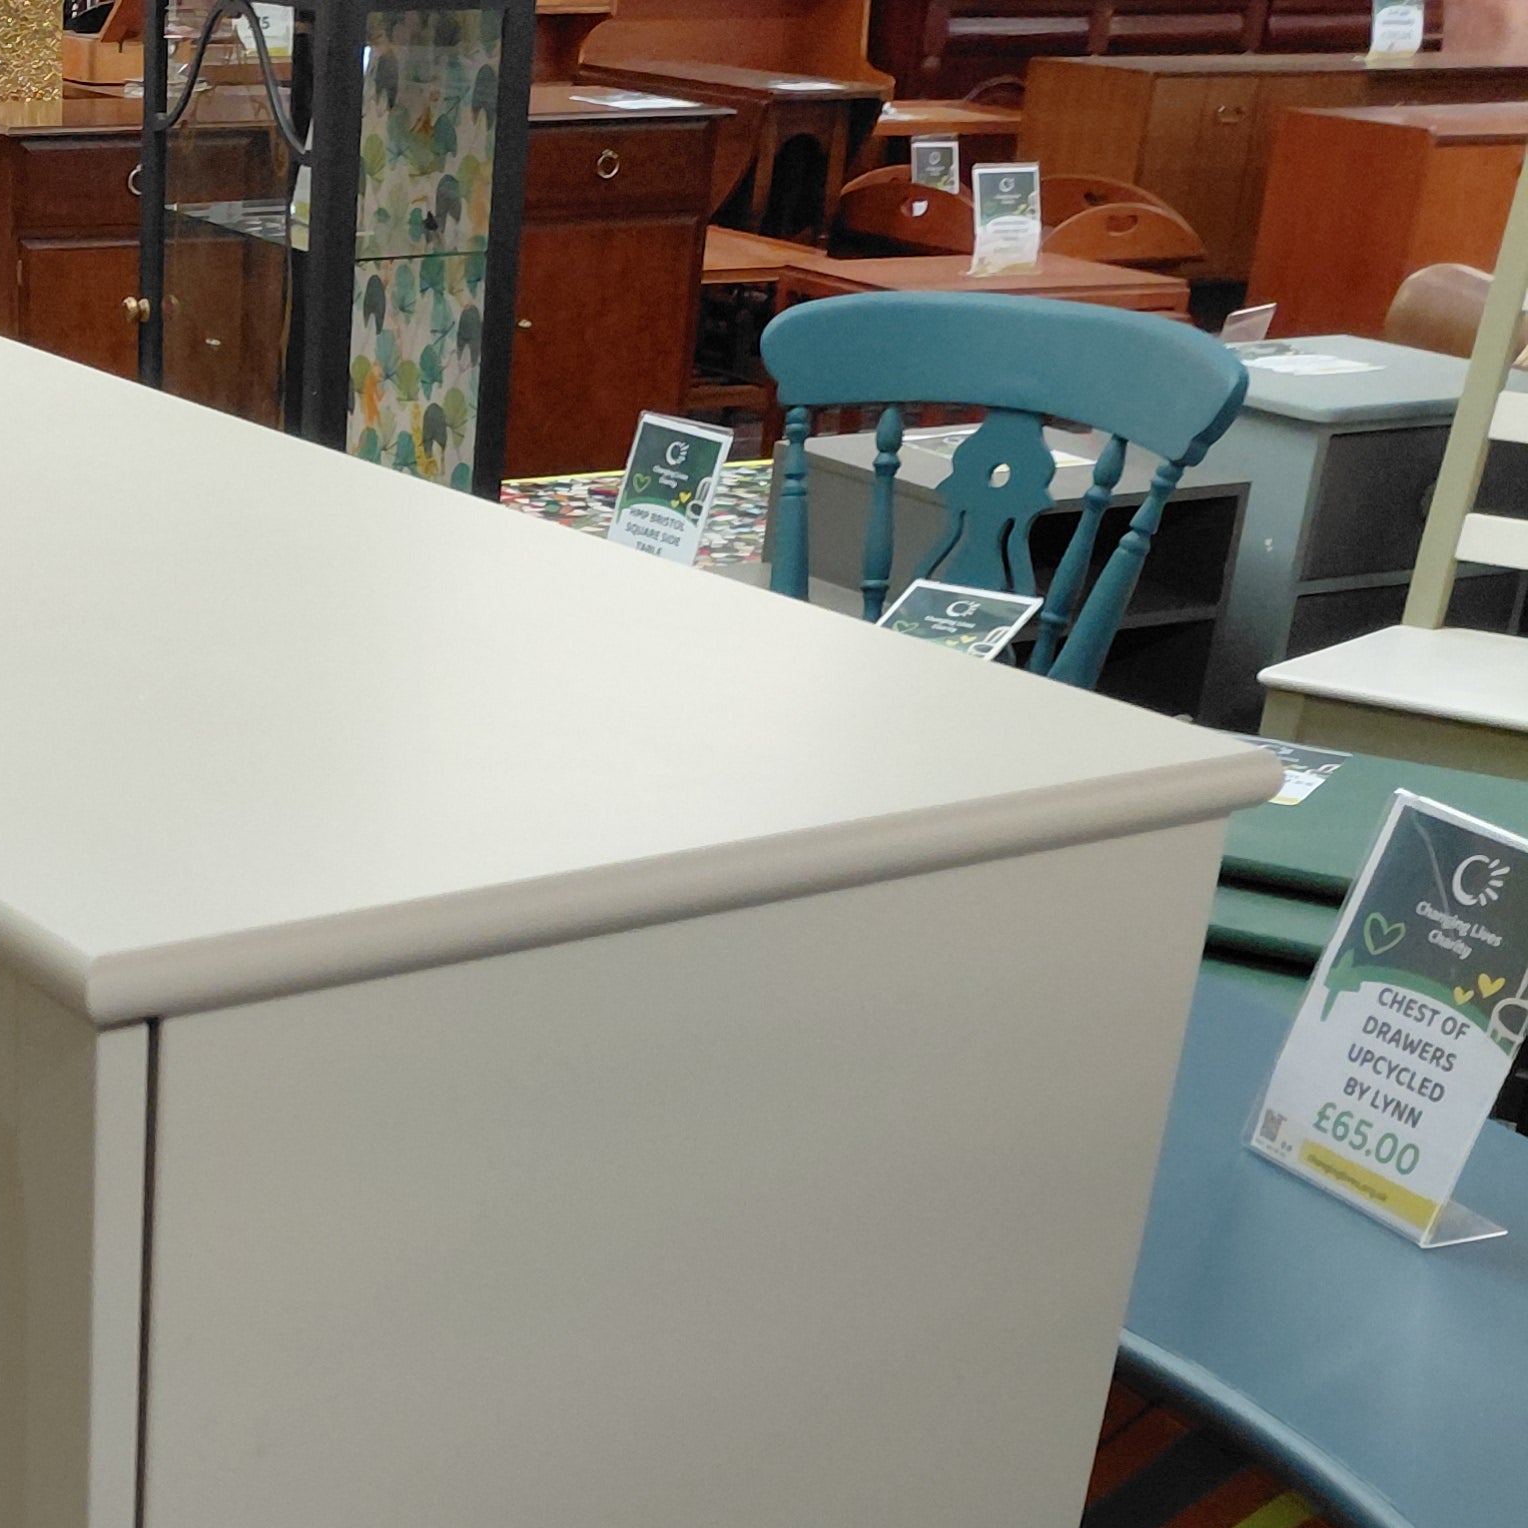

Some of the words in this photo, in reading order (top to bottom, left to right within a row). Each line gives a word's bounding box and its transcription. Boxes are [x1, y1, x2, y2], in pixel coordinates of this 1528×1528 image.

[1415, 900, 1472, 937] Changing
[1470, 923, 1503, 947] Lives
[1428, 929, 1473, 960] Charity
[1378, 987, 1441, 1027] CHEST
[1440, 1016, 1471, 1040] OF
[1362, 1015, 1457, 1072] DRAWERS
[1347, 1043, 1445, 1103] UPCYCLED
[1343, 1076, 1372, 1101] BY
[1369, 1089, 1423, 1129] LYNN
[1313, 1102, 1420, 1175] £65.00
